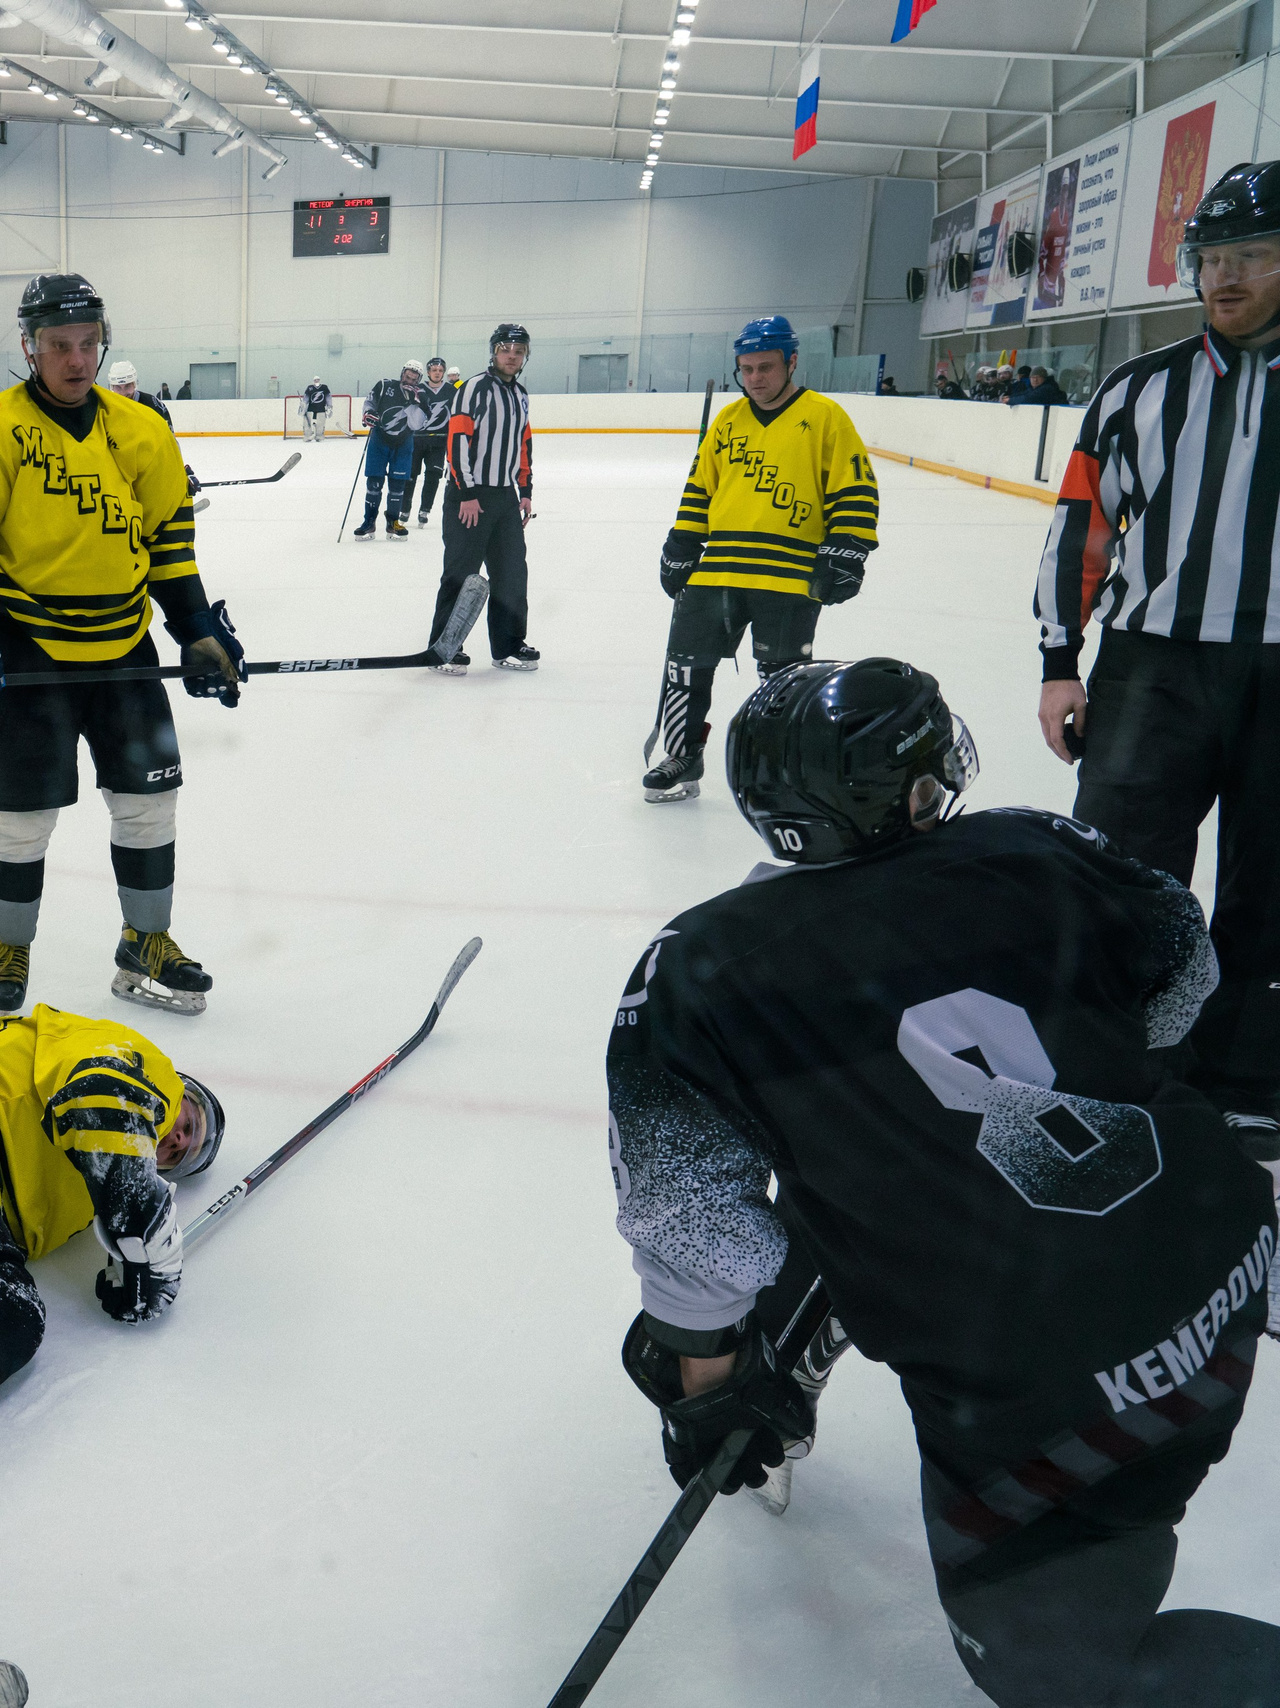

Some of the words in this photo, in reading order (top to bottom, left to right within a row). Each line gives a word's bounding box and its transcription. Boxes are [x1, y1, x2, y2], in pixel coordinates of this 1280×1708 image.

[310, 201, 334, 209] МЕТЕОР
[370, 211, 378, 226] 3
[339, 215, 345, 225] 3
[385, 387, 395, 397] 55
[715, 422, 812, 528] МЕТЕОР
[12, 424, 144, 572] МЕТЕО
[668, 660, 692, 687] 61
[773, 827, 803, 852] 10
[897, 987, 1162, 1216] 8
[207, 1185, 243, 1215] CCM
[1095, 1224, 1273, 1413] KEMEROVO
